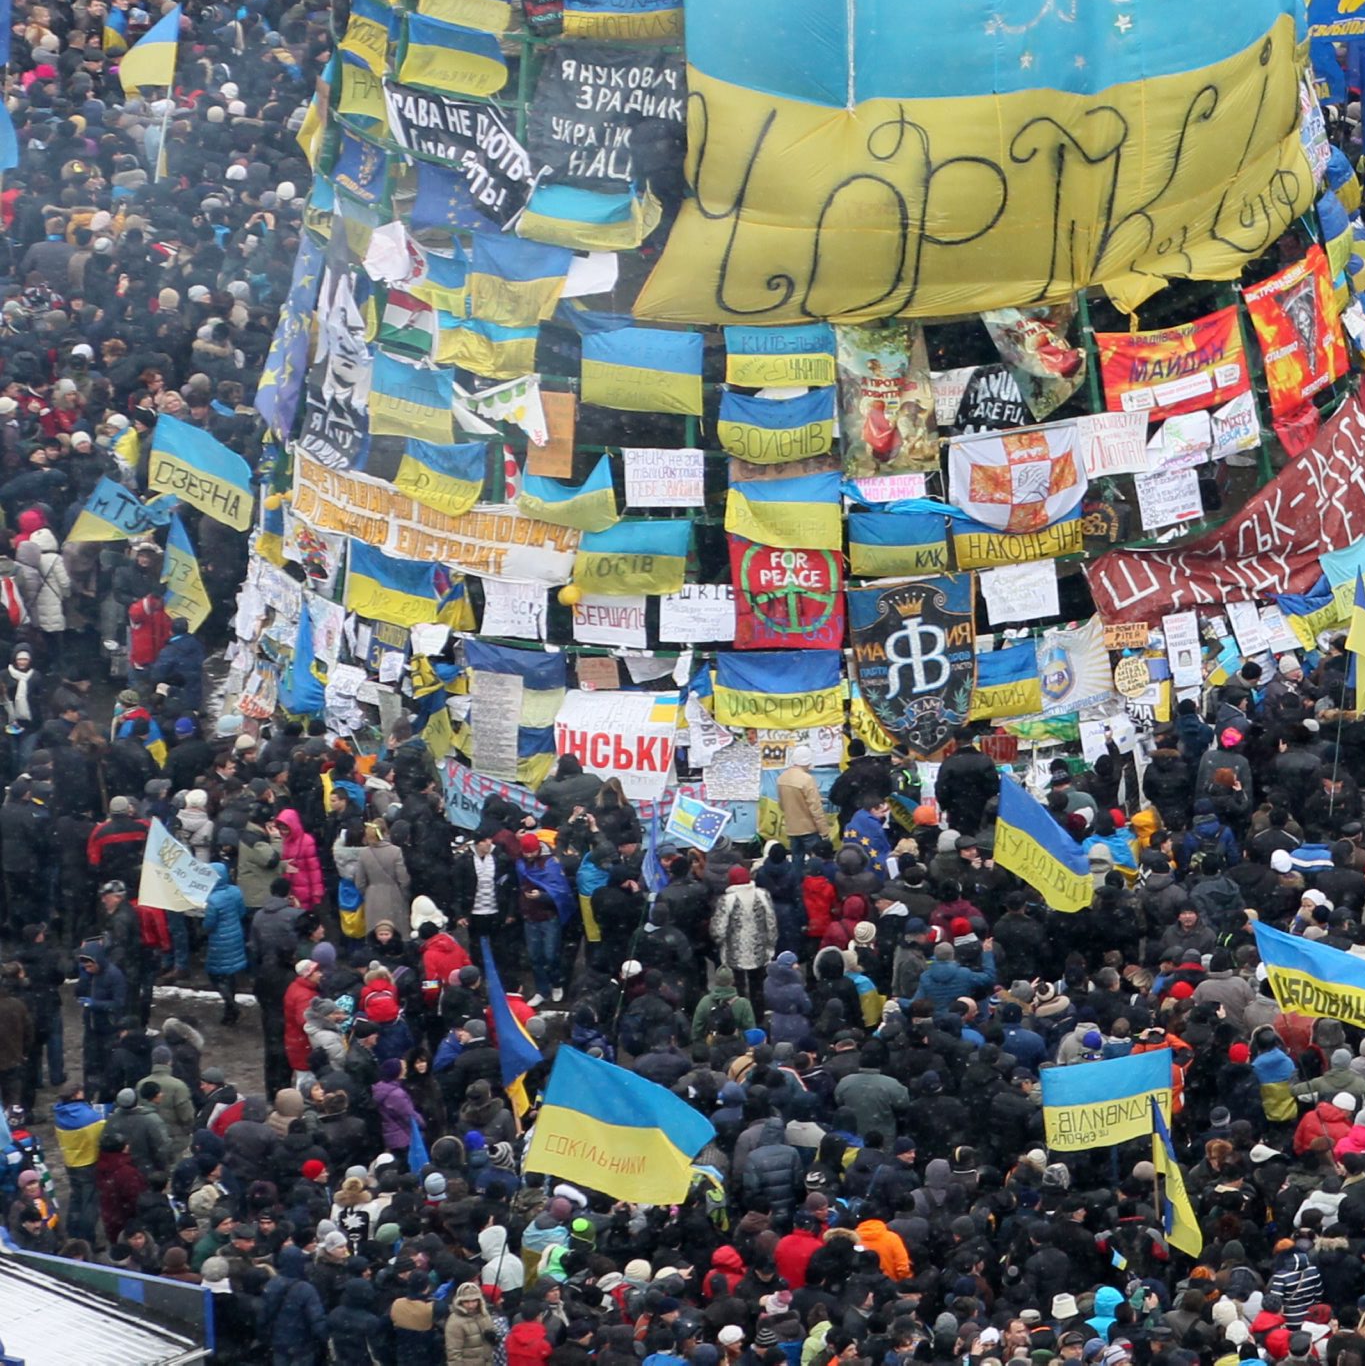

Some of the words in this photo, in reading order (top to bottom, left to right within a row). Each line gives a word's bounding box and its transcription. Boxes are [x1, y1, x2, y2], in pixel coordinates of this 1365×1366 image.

[1129, 347, 1225, 385] МАЙДАН
[730, 423, 826, 459] ЗОЛОЧІВ
[584, 556, 655, 580] КОСІВ
[769, 551, 808, 569] FOR
[759, 570, 824, 589] PEACE
[543, 1133, 649, 1177] СОКІЛЬНИКИ
